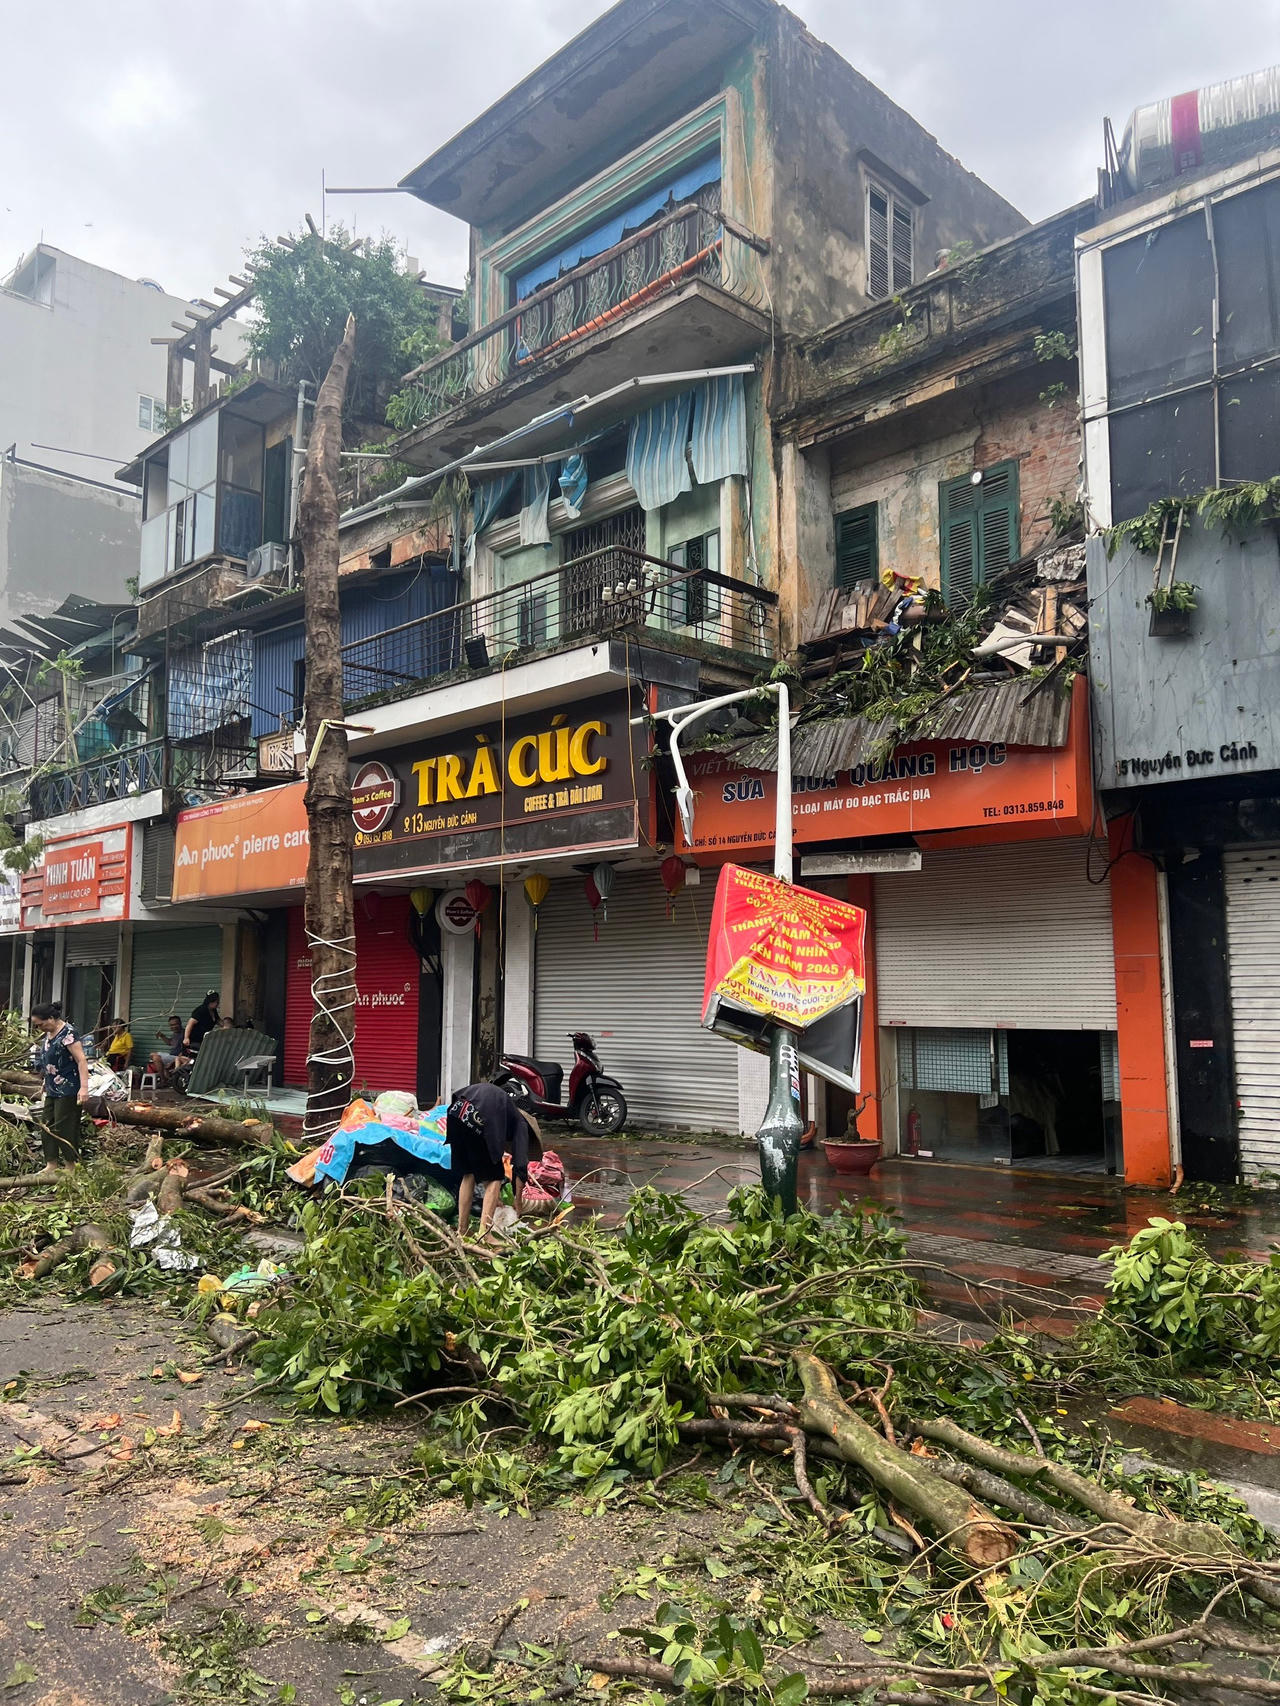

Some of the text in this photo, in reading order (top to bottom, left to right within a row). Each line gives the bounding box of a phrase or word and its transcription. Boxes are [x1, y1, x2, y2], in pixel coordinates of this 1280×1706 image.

[411, 713, 607, 807] TRÀ CÚC
[722, 774, 765, 803] SỬA
[850, 752, 936, 787] QUANG
[949, 742, 1007, 774] HỌC
[352, 789, 393, 805] ham'S Coffee
[524, 794, 547, 813] COFFEE
[548, 793, 555, 809] &
[555, 787, 569, 807] TRÀ
[800, 802, 820, 815] LOẠI
[823, 797, 844, 812] MÁY
[862, 796, 881, 809] ĐẠC
[884, 788, 911, 805] TRẮC
[912, 788, 931, 803] ĐỊA
[983, 799, 1064, 818] TEL: 0313.859.848
[412, 811, 423, 834] 13
[242, 834, 280, 859] pierre
[708, 834, 717, 845] SỐ
[719, 836, 726, 845] 14
[46, 862, 68, 887] MINH
[70, 849, 96, 883] TUẤN
[796, 940, 828, 959] NHÌN
[748, 963, 779, 987] TÂN
[806, 963, 839, 976] 2045
[747, 977, 770, 994] TRUNG
